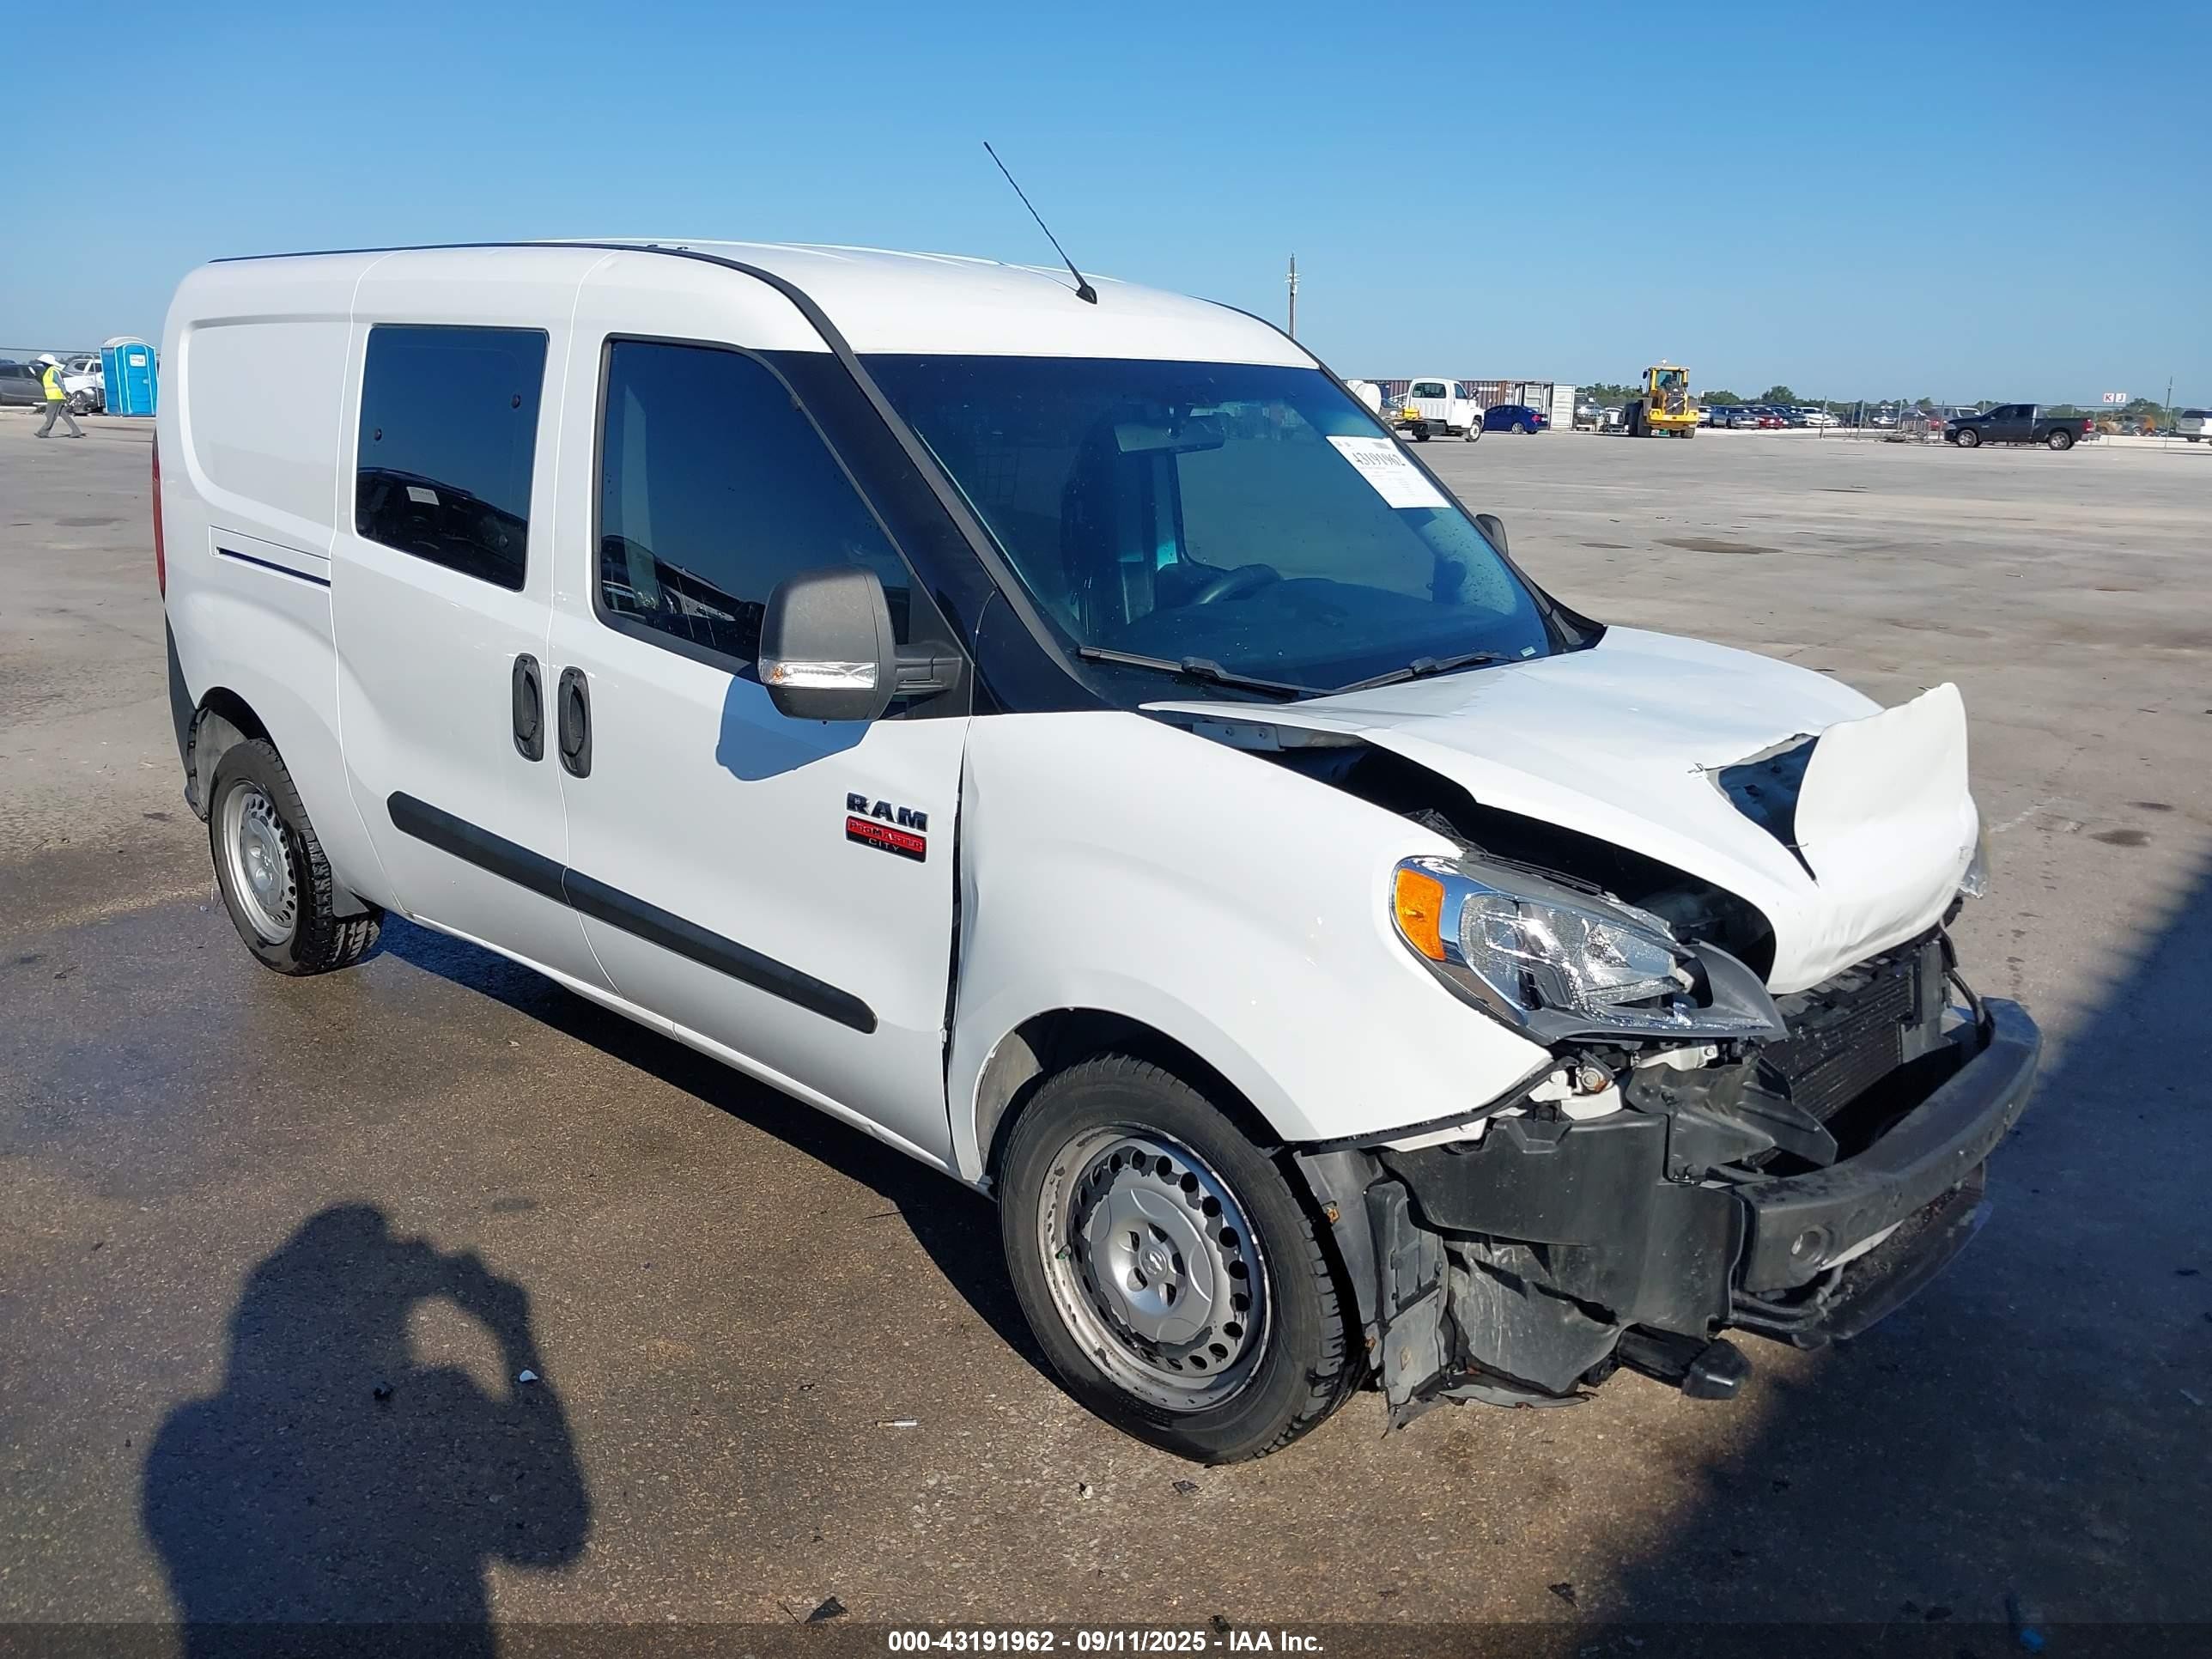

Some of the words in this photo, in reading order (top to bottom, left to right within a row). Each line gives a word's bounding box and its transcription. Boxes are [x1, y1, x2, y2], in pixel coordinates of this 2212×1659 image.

[1352, 452, 1406, 466] 43191962
[846, 792, 928, 833] RAM
[868, 837, 900, 852] CITY
